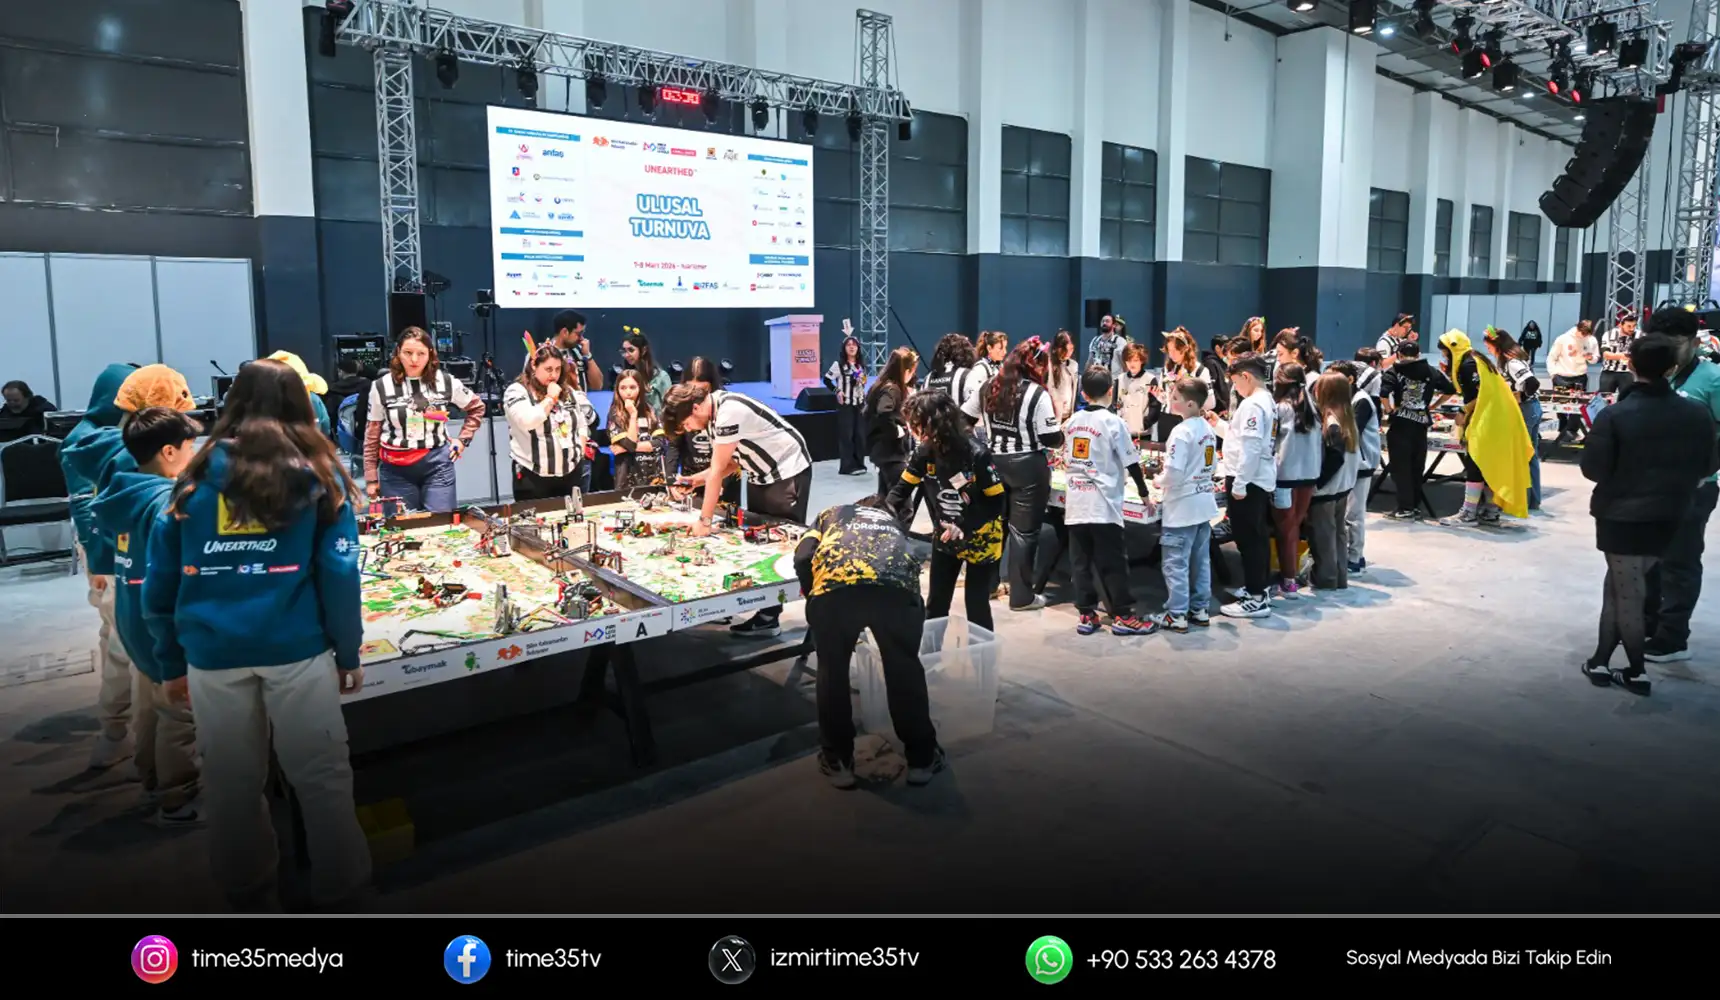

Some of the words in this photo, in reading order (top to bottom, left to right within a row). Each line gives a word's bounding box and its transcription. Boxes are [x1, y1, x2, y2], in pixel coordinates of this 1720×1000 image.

[636, 194, 703, 218] ULUSAL
[629, 217, 711, 240] TURNUVA
[203, 538, 277, 554] UNEARTHED
[635, 621, 649, 638] A
